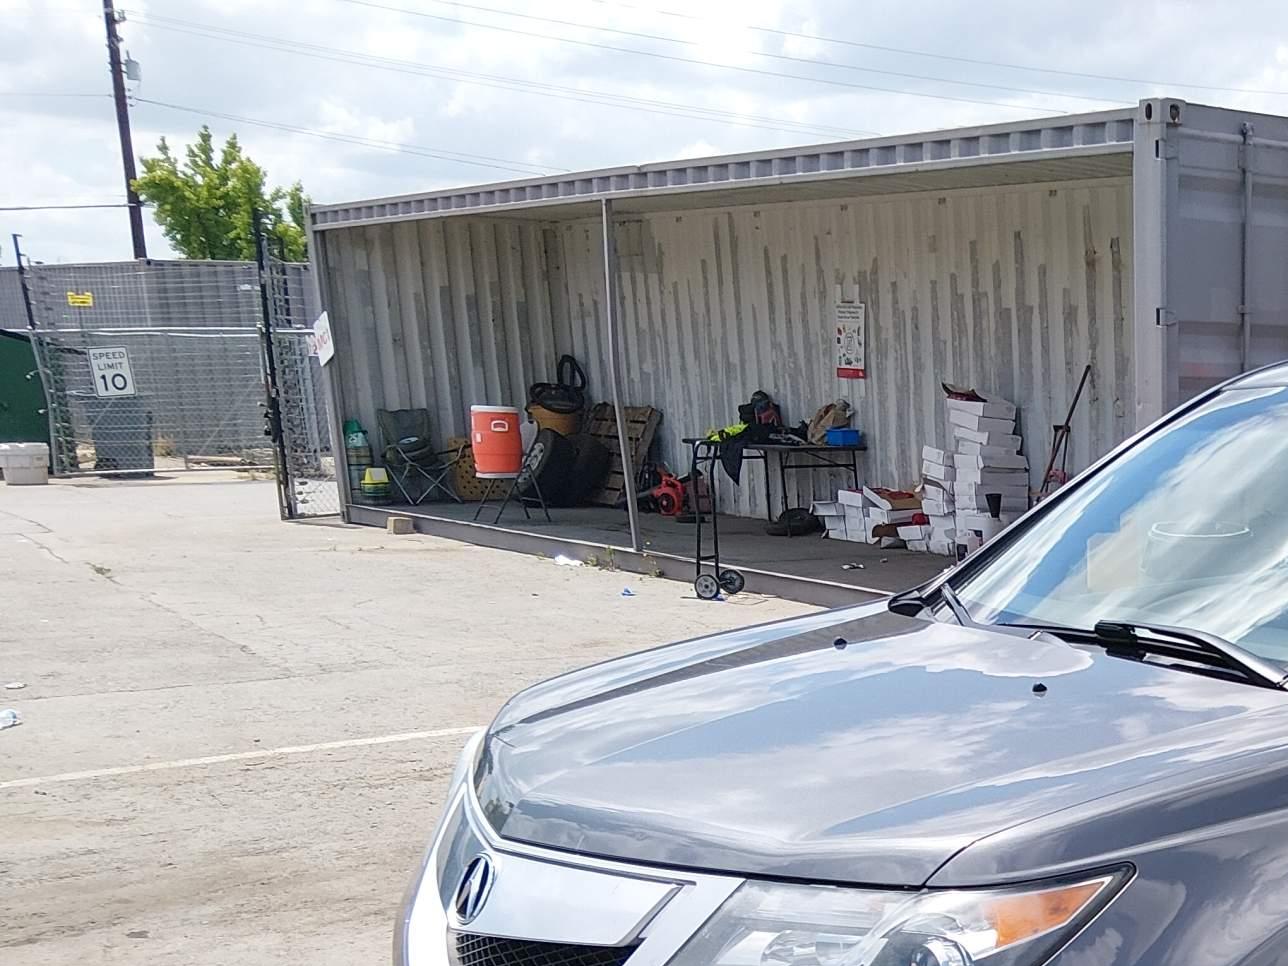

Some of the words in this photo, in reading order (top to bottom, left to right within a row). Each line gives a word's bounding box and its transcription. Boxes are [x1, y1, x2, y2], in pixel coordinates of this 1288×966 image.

[92, 351, 126, 361] SPEED
[97, 361, 124, 371] LIMIT
[100, 373, 127, 391] 10
